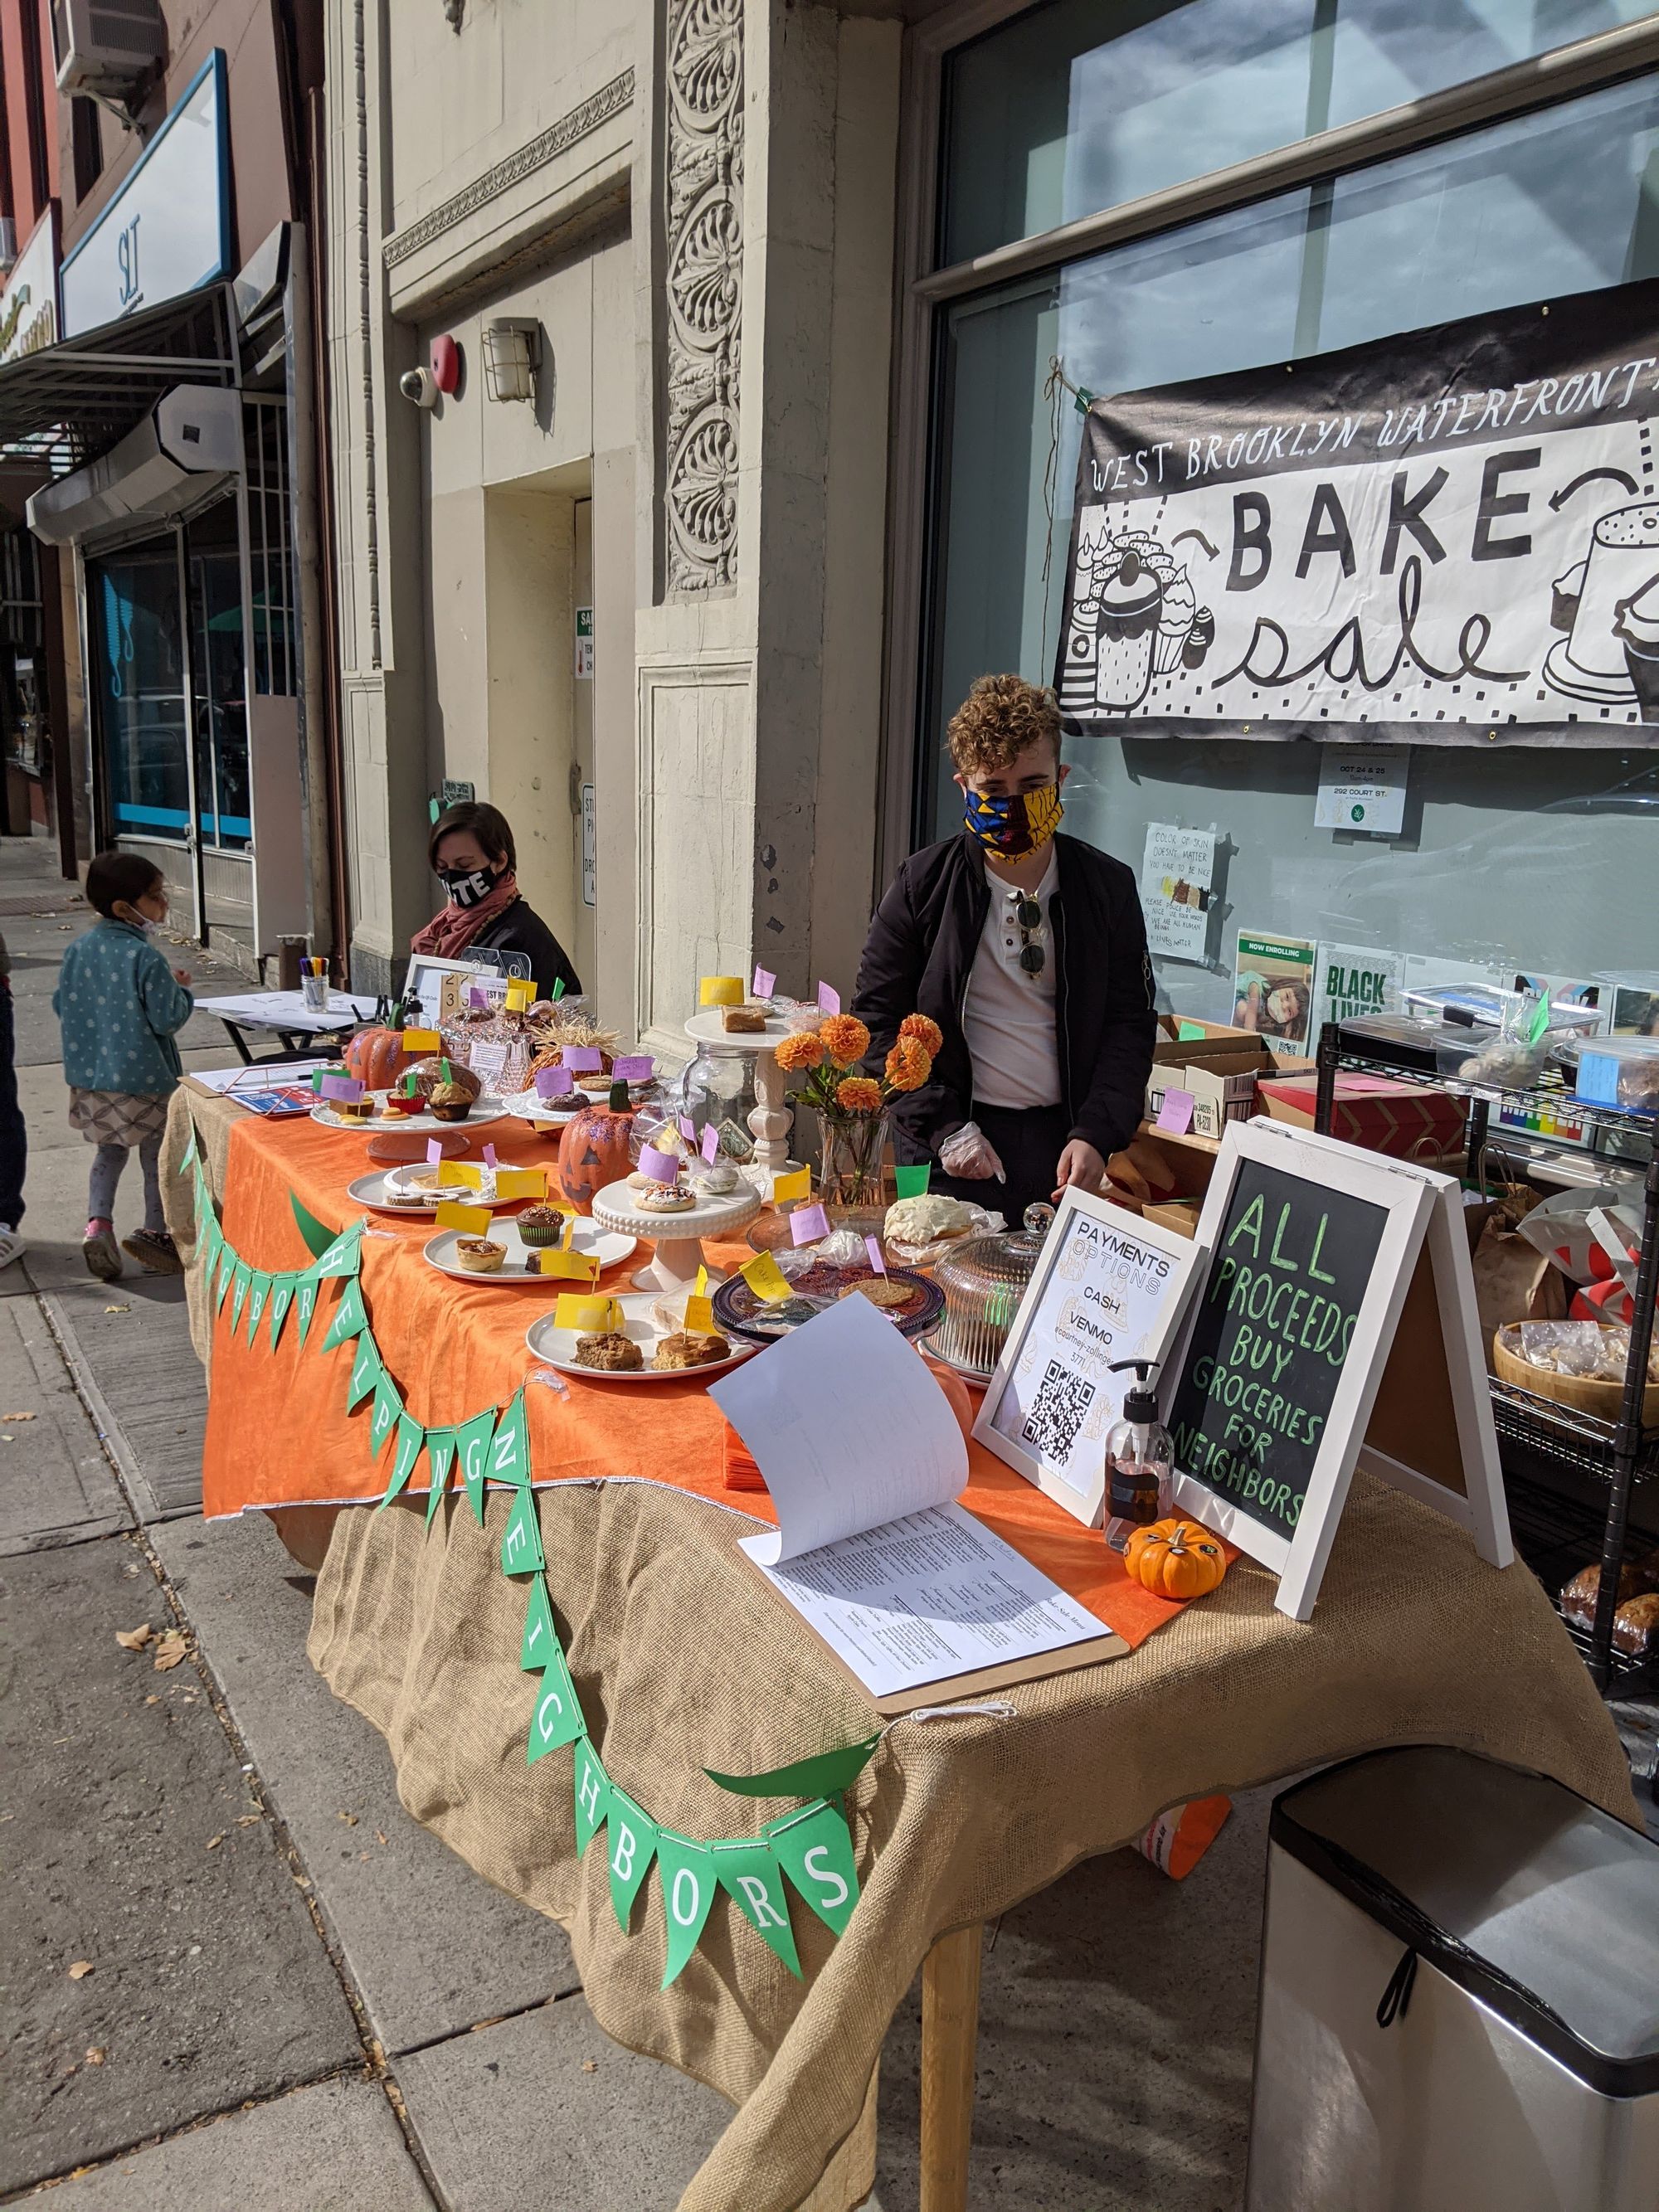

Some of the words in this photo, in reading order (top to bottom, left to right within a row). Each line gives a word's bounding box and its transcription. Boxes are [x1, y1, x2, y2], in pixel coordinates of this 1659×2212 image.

[1091, 441, 1173, 493] WEST
[1185, 414, 1365, 480] BROOKLYN
[1377, 357, 1657, 447] WATERFRONT
[1225, 448, 1542, 592] BAKE
[1212, 555, 1532, 691] sale
[1155, 832, 1176, 844] COLOR
[1181, 836, 1190, 845] OF
[1194, 839, 1209, 848] SKIN
[1183, 851, 1207, 862] MATTER
[1150, 859, 1159, 869] YOU
[1162, 862, 1174, 872] HAVE
[1178, 863, 1185, 873] TO
[1189, 865, 1195, 874] BE
[1198, 868, 1211, 878] NICE
[438, 872, 490, 907] TE
[1146, 897, 1163, 907] PLEASE
[1166, 902, 1182, 912] POLICE
[1152, 907, 1164, 916] NICE
[1183, 921, 1201, 931] HUMAN
[1156, 935, 1172, 947] LIVES
[1174, 939, 1191, 947] MATTER
[1248, 942, 1264, 951] NOW
[1265, 946, 1300, 957] ENROLLING
[445, 993, 455, 1007] 3
[1326, 965, 1387, 1005] BLACK
[1331, 999, 1382, 1022] LIV
[1077, 1221, 1171, 1279] PAYMENTS
[1228, 1193, 1336, 1286] ALL
[1073, 1239, 1162, 1297] OPTIONS
[1082, 1286, 1121, 1315] CASH
[1210, 1256, 1359, 1369] PROCEEDS
[1068, 1310, 1114, 1346] VENMO
[1229, 1324, 1294, 1384] BUY
[1192, 1355, 1324, 1446] GROCERIES
[1224, 1412, 1273, 1465] FOR
[1174, 1421, 1306, 1528] NEIGHBORS
